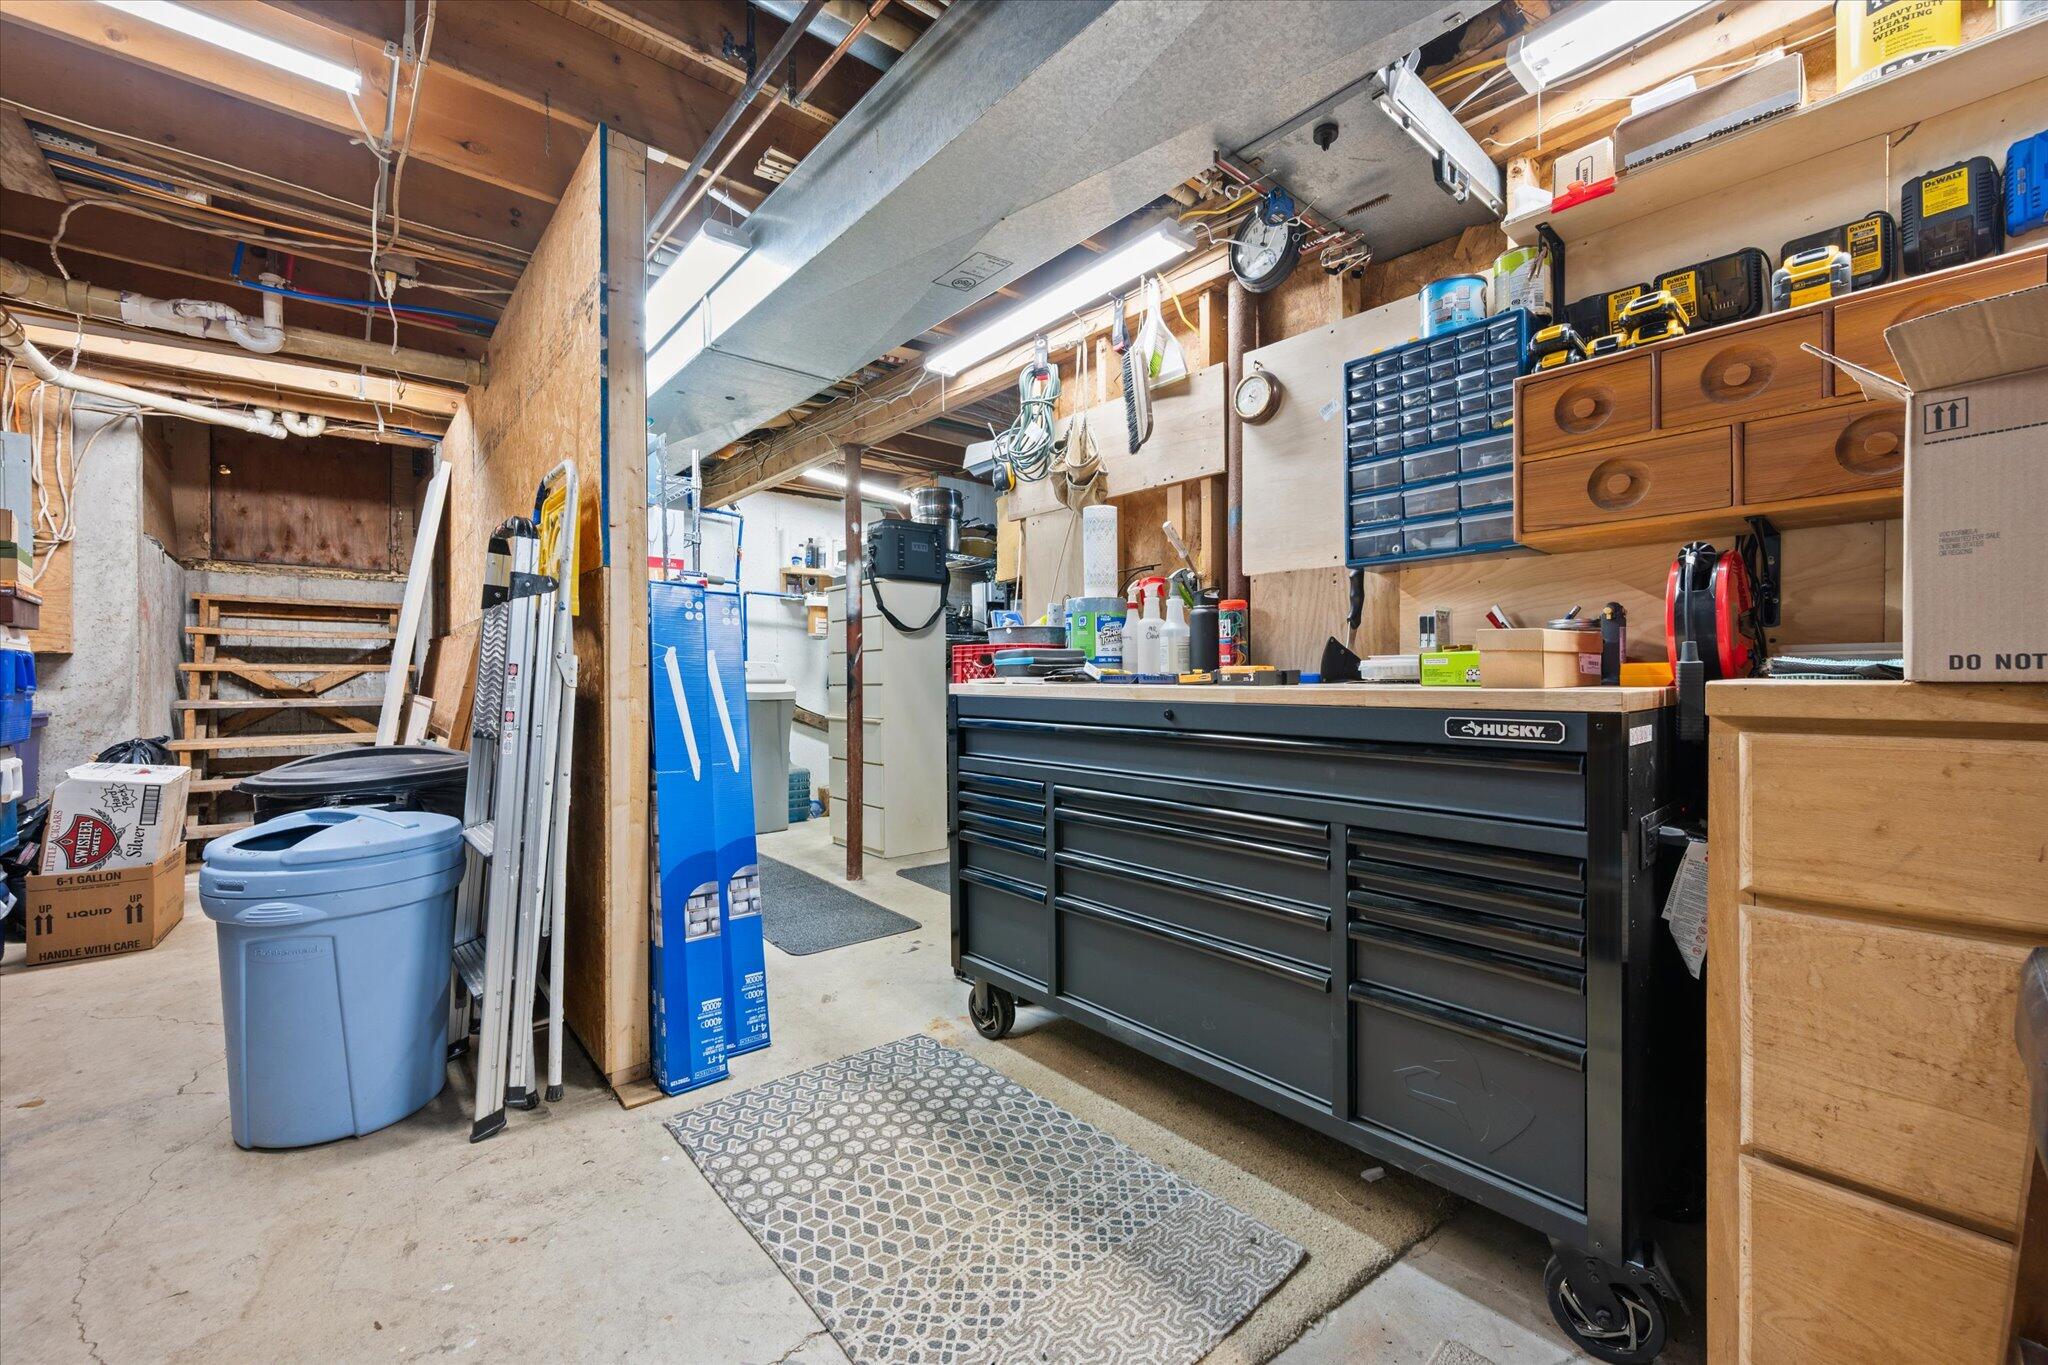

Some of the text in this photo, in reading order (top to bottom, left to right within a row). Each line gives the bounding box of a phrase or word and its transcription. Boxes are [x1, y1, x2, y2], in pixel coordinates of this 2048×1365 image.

[1872, 5, 1911, 28] HEAVY
[1915, 0, 1944, 12] DUTY
[1872, 8, 1933, 35] CLEANING
[1873, 22, 1910, 42] WIPES
[1949, 652, 2048, 671] DO NOT
[1482, 723, 1545, 738] HUSKY
[109, 789, 123, 808] Hard
[117, 788, 131, 806] Pack
[44, 809, 63, 872] LITTLE CIGARS
[74, 820, 94, 863] SWISHER
[90, 827, 103, 856] SWEETS
[125, 825, 147, 858] Silver
[56, 871, 122, 886] 6-1 GALLON
[129, 894, 142, 903] UP
[38, 904, 52, 914] UP
[66, 907, 112, 919] LIQUID
[39, 940, 141, 962] HANDLE WITH CARE
[704, 1017, 722, 1028] 4000
[750, 1022, 767, 1032] 4-FT
[707, 1053, 725, 1064] 4-FT
